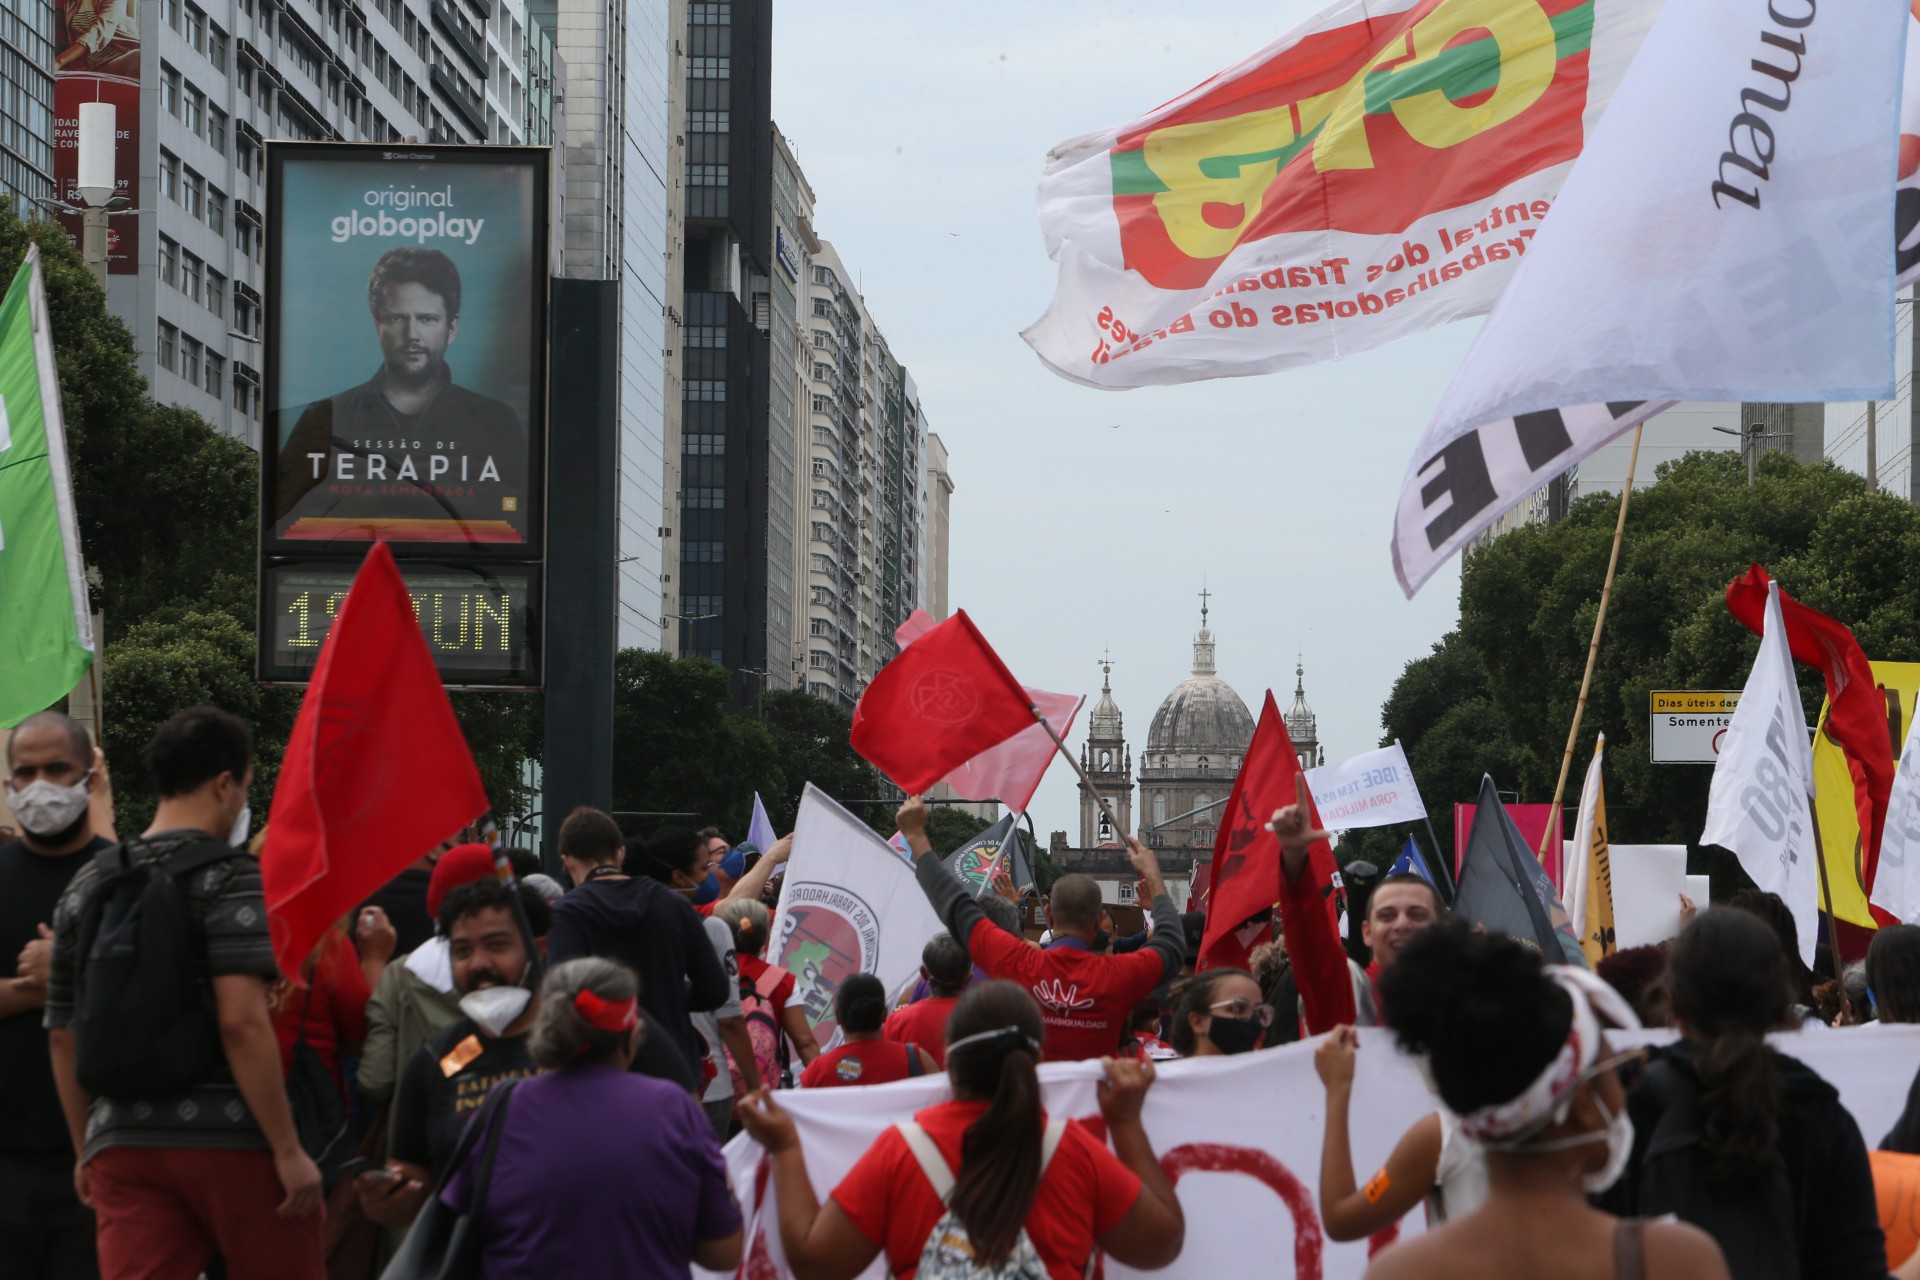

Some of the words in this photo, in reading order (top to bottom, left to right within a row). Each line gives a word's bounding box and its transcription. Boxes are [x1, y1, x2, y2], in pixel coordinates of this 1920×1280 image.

[116, 130, 130, 139] DE
[363, 184, 454, 211] original
[331, 209, 485, 245] globoplay
[353, 438, 421, 449] SESSÃO
[436, 441, 455, 449] DE
[306, 452, 501, 482] TERAPIA
[329, 483, 373, 496] NOVA
[380, 483, 476, 497] TEMPORADA
[1658, 698, 1683, 708] Dias
[1687, 697, 1716, 708] úteis
[1719, 697, 1738, 708] das
[1668, 716, 1730, 727] Somente
